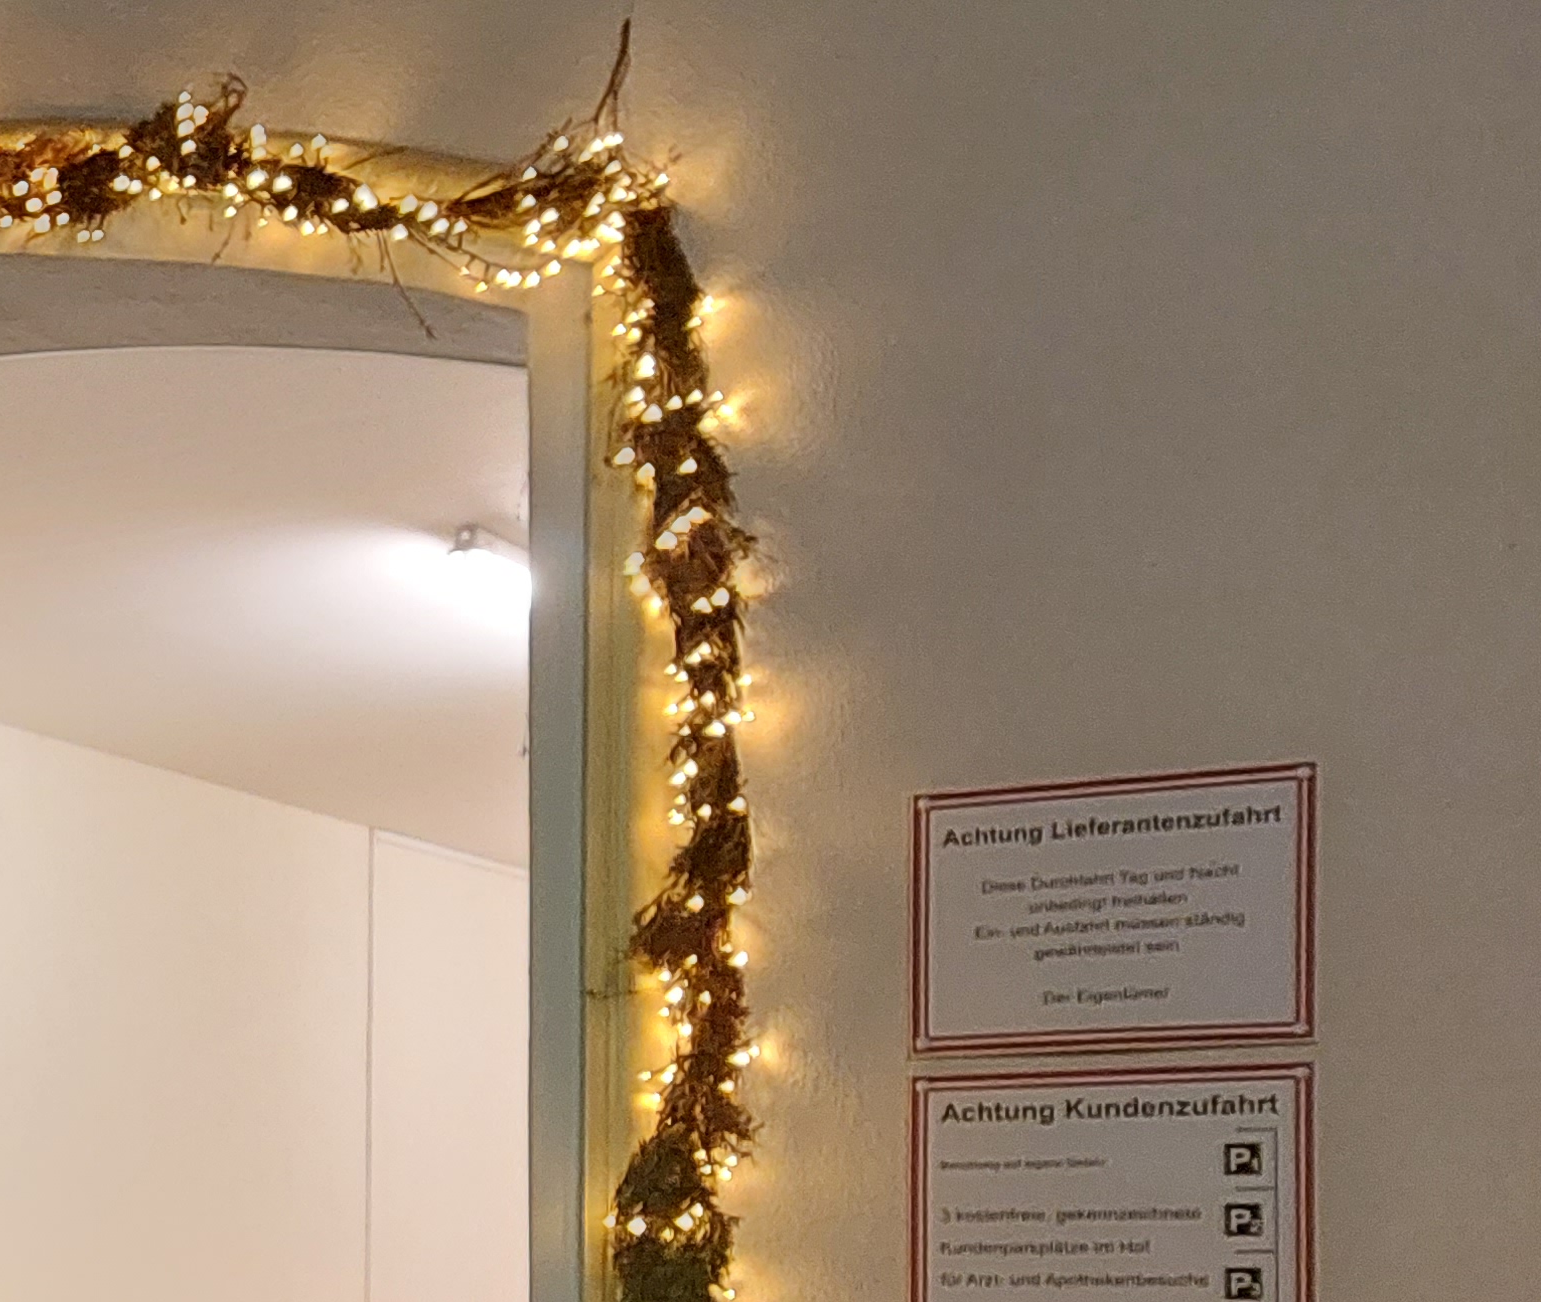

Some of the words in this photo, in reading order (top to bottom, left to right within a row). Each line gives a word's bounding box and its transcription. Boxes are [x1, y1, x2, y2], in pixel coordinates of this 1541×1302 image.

[942, 824, 1044, 848] Achtung
[1052, 805, 1282, 842] Lieferantenzufahrt
[1185, 910, 1246, 929] ständig
[941, 1099, 1055, 1125] Achtung
[1064, 1093, 1280, 1120] Kundenzufahrt
